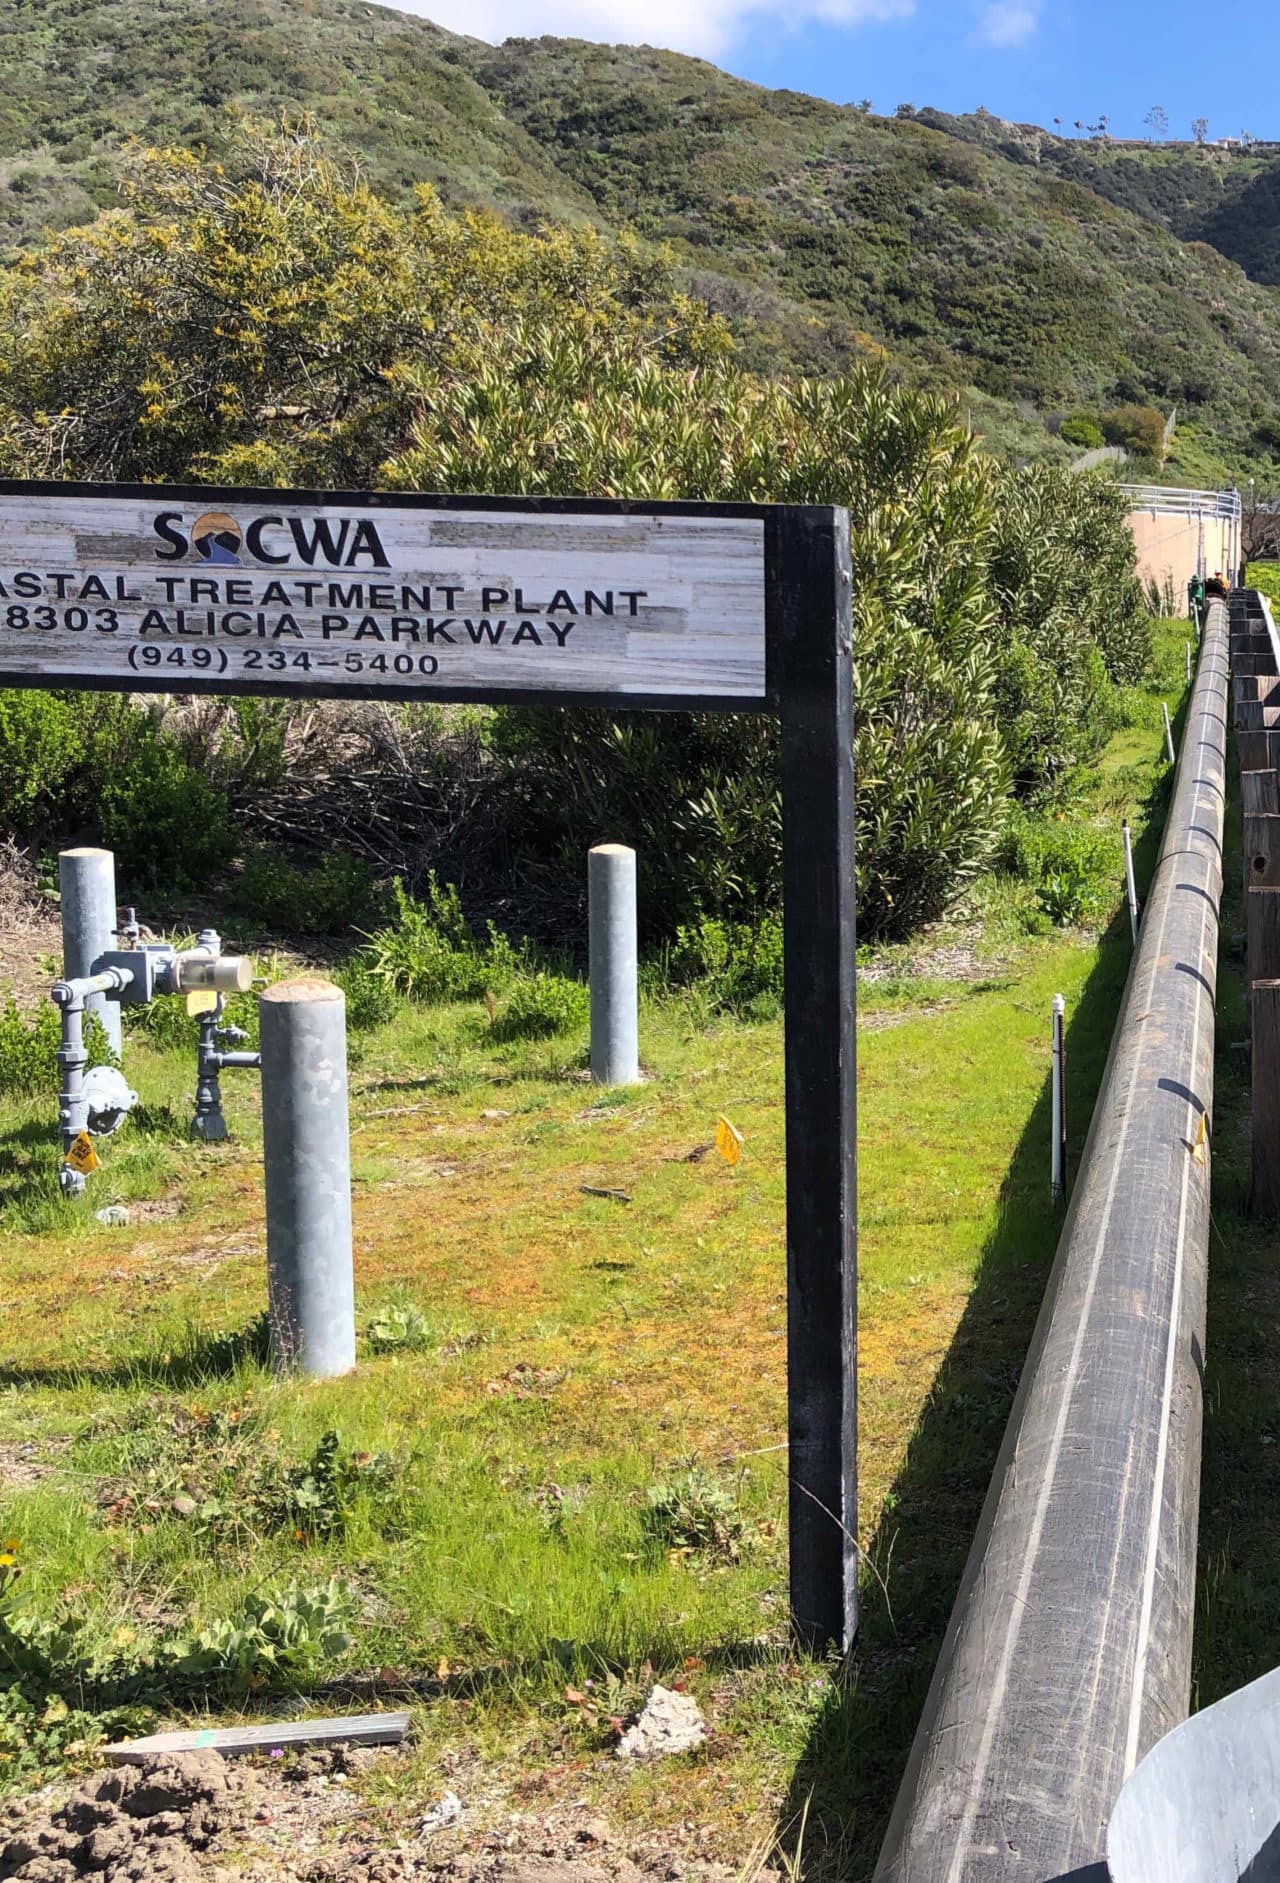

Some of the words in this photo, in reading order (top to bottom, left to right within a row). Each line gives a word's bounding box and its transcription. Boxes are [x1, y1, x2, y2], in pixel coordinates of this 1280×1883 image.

[0, 572, 142, 602] STAL
[155, 577, 465, 614] TREATMENT
[481, 587, 648, 617] PLANT
[6, 605, 119, 633] 8303
[138, 609, 304, 639] ALICIA
[321, 614, 576, 647] PARKWAY
[127, 644, 229, 674] (949)
[243, 649, 439, 676] 234-5400
